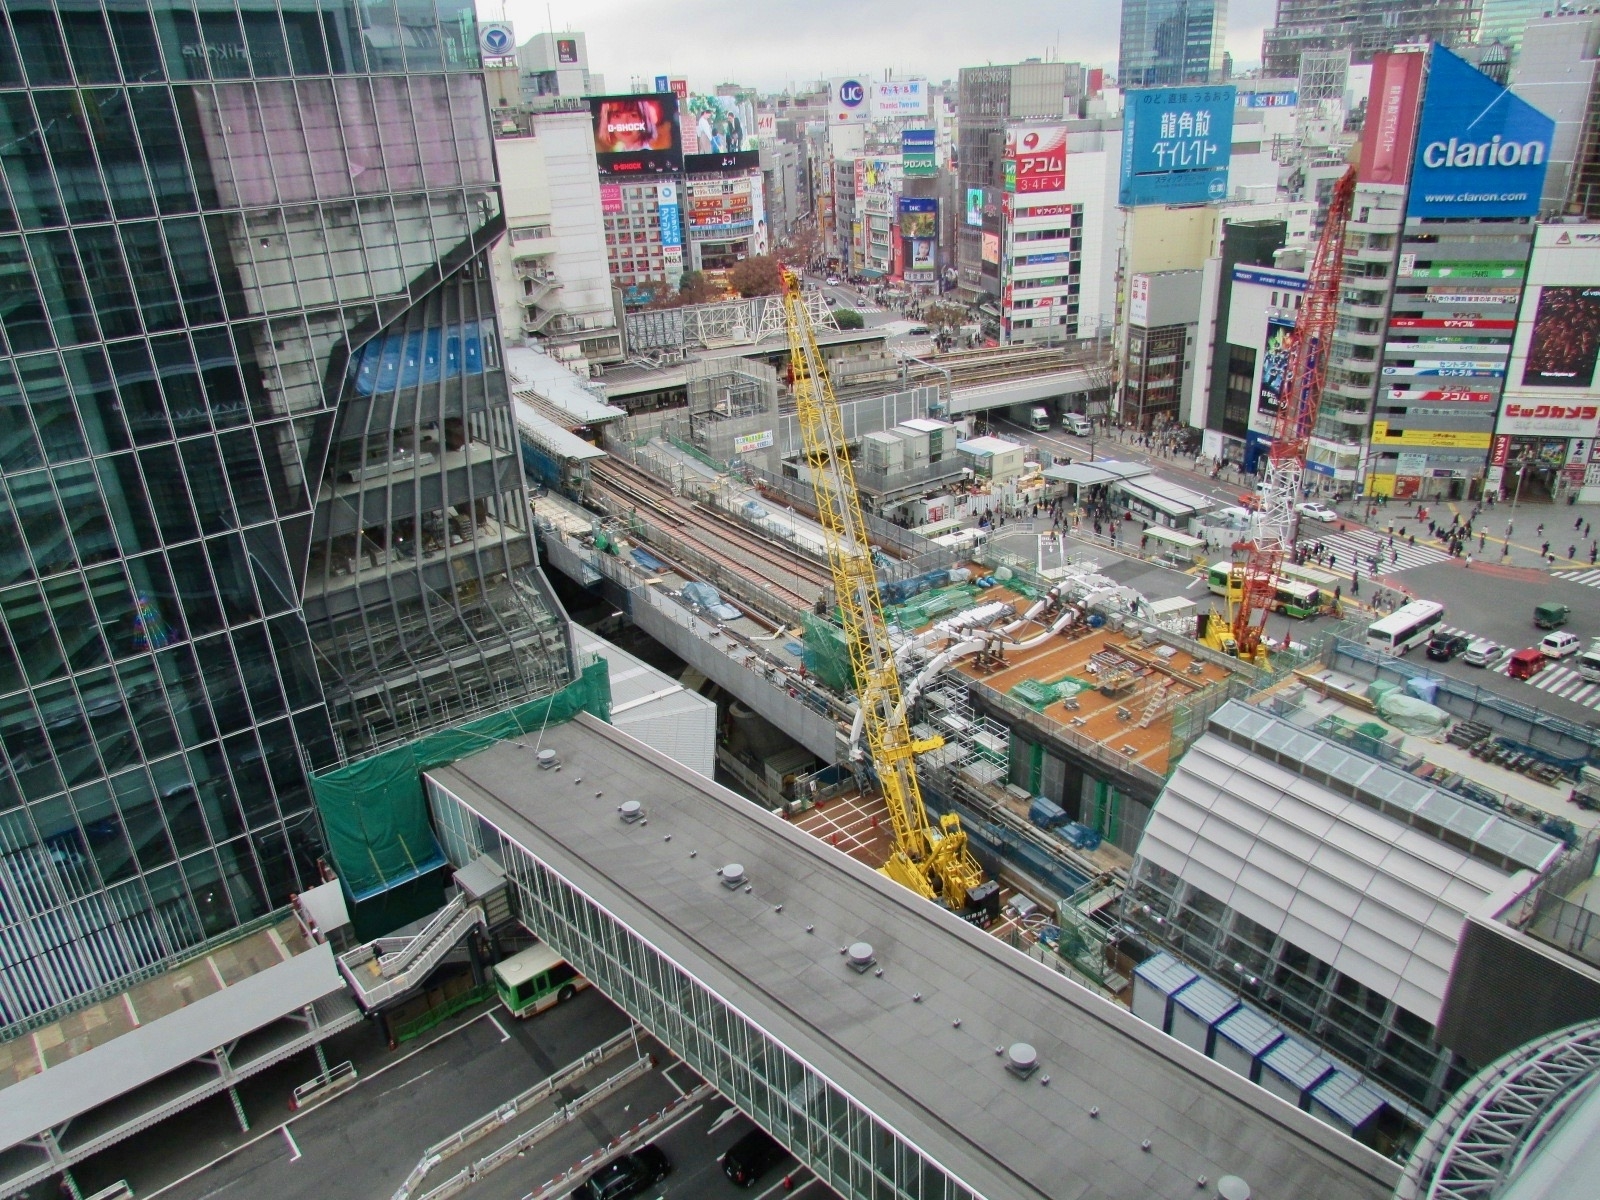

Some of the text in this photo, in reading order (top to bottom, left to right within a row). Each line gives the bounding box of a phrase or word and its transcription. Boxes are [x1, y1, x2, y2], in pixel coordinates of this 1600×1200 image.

[842, 87, 862, 101] UC
[1255, 95, 1289, 106] SEIBU
[608, 122, 646, 132] G-SHOCK
[1161, 110, 1211, 139] 龍角散
[1152, 140, 1218, 168] ダイレクト
[613, 163, 642, 171] G-SHOCK
[1020, 156, 1062, 174] アコム
[1209, 184, 1225, 193] 生薬
[1425, 192, 1528, 202] www.clarion.com
[1440, 393, 1470, 401] アコム
[1505, 404, 1598, 420] ビックカメラ
